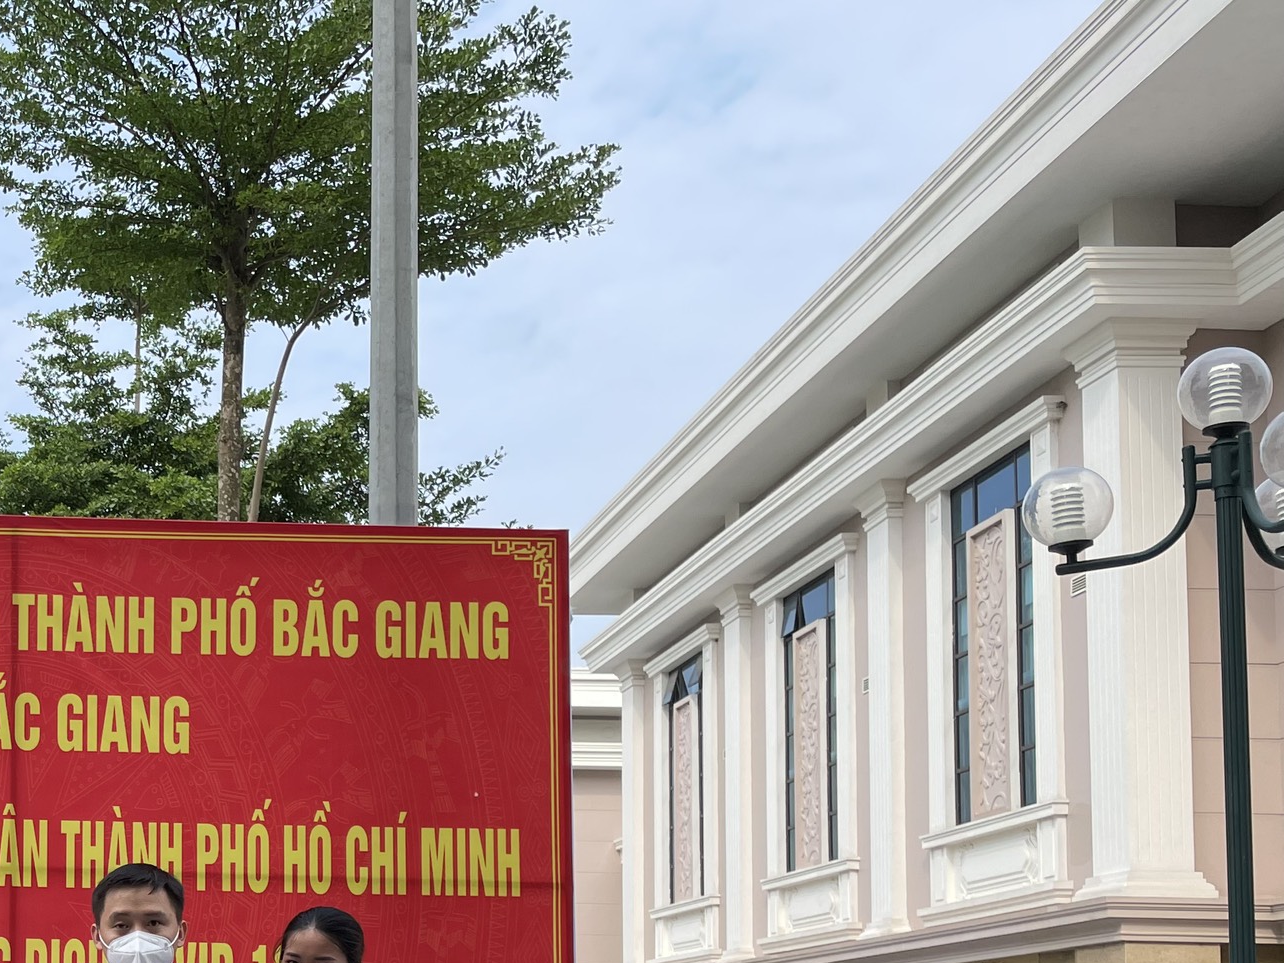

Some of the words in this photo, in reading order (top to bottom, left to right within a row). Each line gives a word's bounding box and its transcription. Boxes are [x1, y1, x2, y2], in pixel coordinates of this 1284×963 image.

[12, 582, 155, 654] THÀNH
[171, 576, 258, 656] PHỐ
[273, 579, 358, 658] BẮC
[376, 599, 509, 660] GIANG
[57, 693, 190, 754] GIANG
[197, 798, 271, 893] PHỐ
[283, 801, 332, 894] HỒ
[346, 811, 407, 895] CHÍ
[421, 826, 521, 897] MINH
